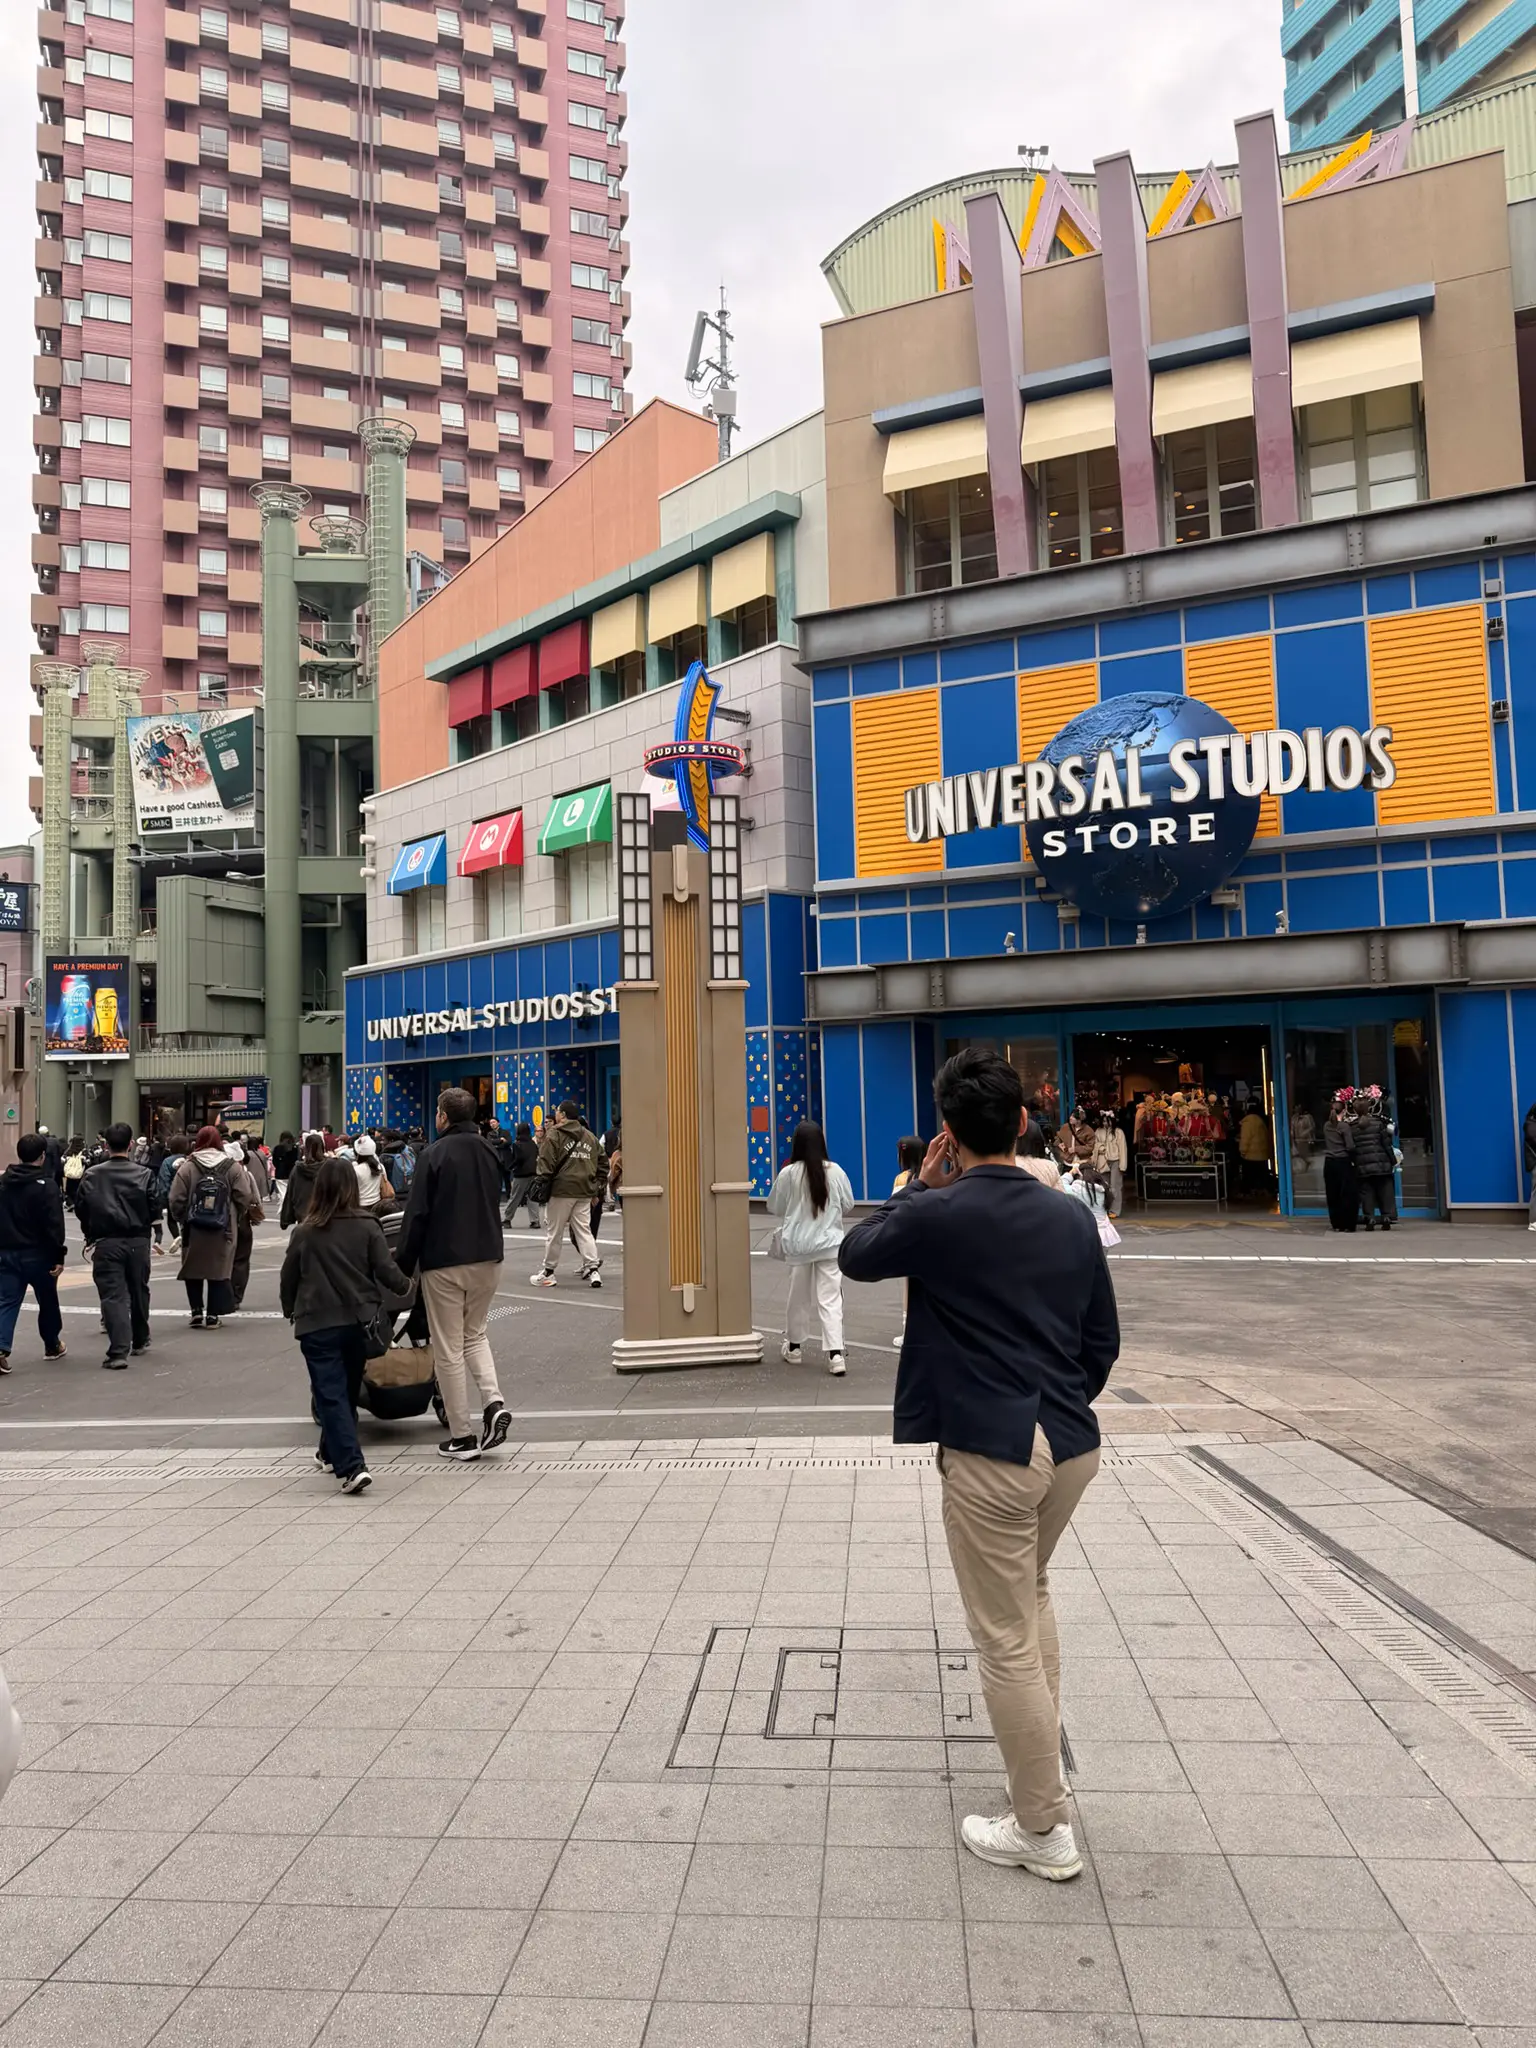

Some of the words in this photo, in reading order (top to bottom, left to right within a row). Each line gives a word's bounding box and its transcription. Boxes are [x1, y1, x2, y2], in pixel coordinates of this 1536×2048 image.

[215, 741, 228, 750] CARD
[646, 745, 695, 760] STUDIOS
[702, 745, 737, 757] STORE
[904, 744, 1153, 844] UNIVERSAL
[1169, 725, 1397, 803] STUDIOS
[140, 804, 158, 813] Have
[160, 804, 165, 812] a
[167, 802, 185, 813] good
[187, 800, 222, 810] Cashless.
[150, 818, 171, 828] SMBC
[175, 815, 223, 827] 三井住友カード
[1042, 812, 1216, 858] STORE
[53, 963, 69, 971] HAVE
[367, 1007, 478, 1041] UNIVERSAL
[483, 991, 584, 1028] STUDIOS
